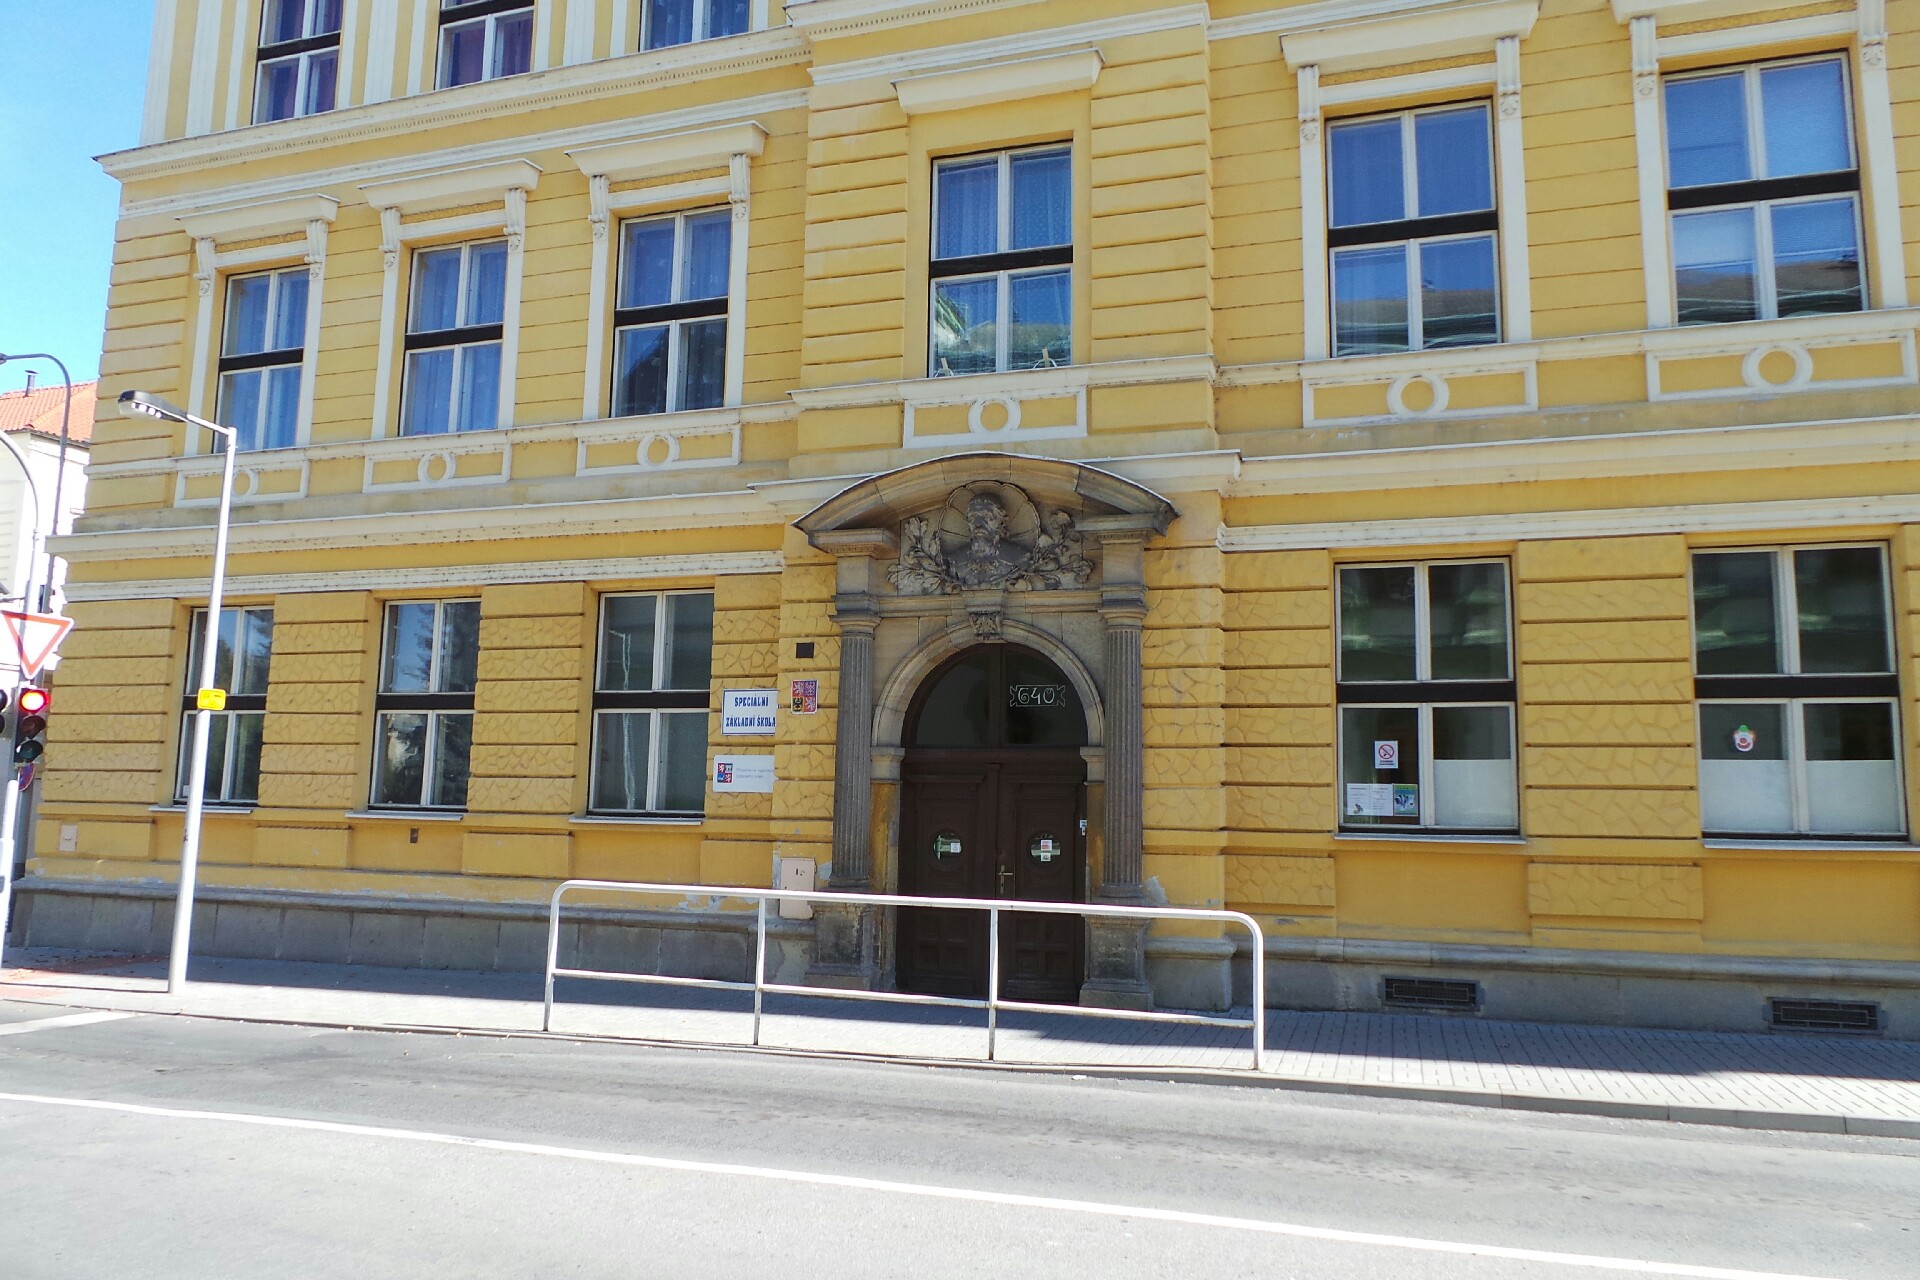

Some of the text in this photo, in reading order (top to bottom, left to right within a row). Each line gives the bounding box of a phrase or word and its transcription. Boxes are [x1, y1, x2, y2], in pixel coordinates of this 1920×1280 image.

[734, 693, 769, 707] SPECIÁLNÍ
[1018, 687, 1055, 704] 640
[726, 715, 776, 727] ZÁKLADNÍ ŠKOLA
